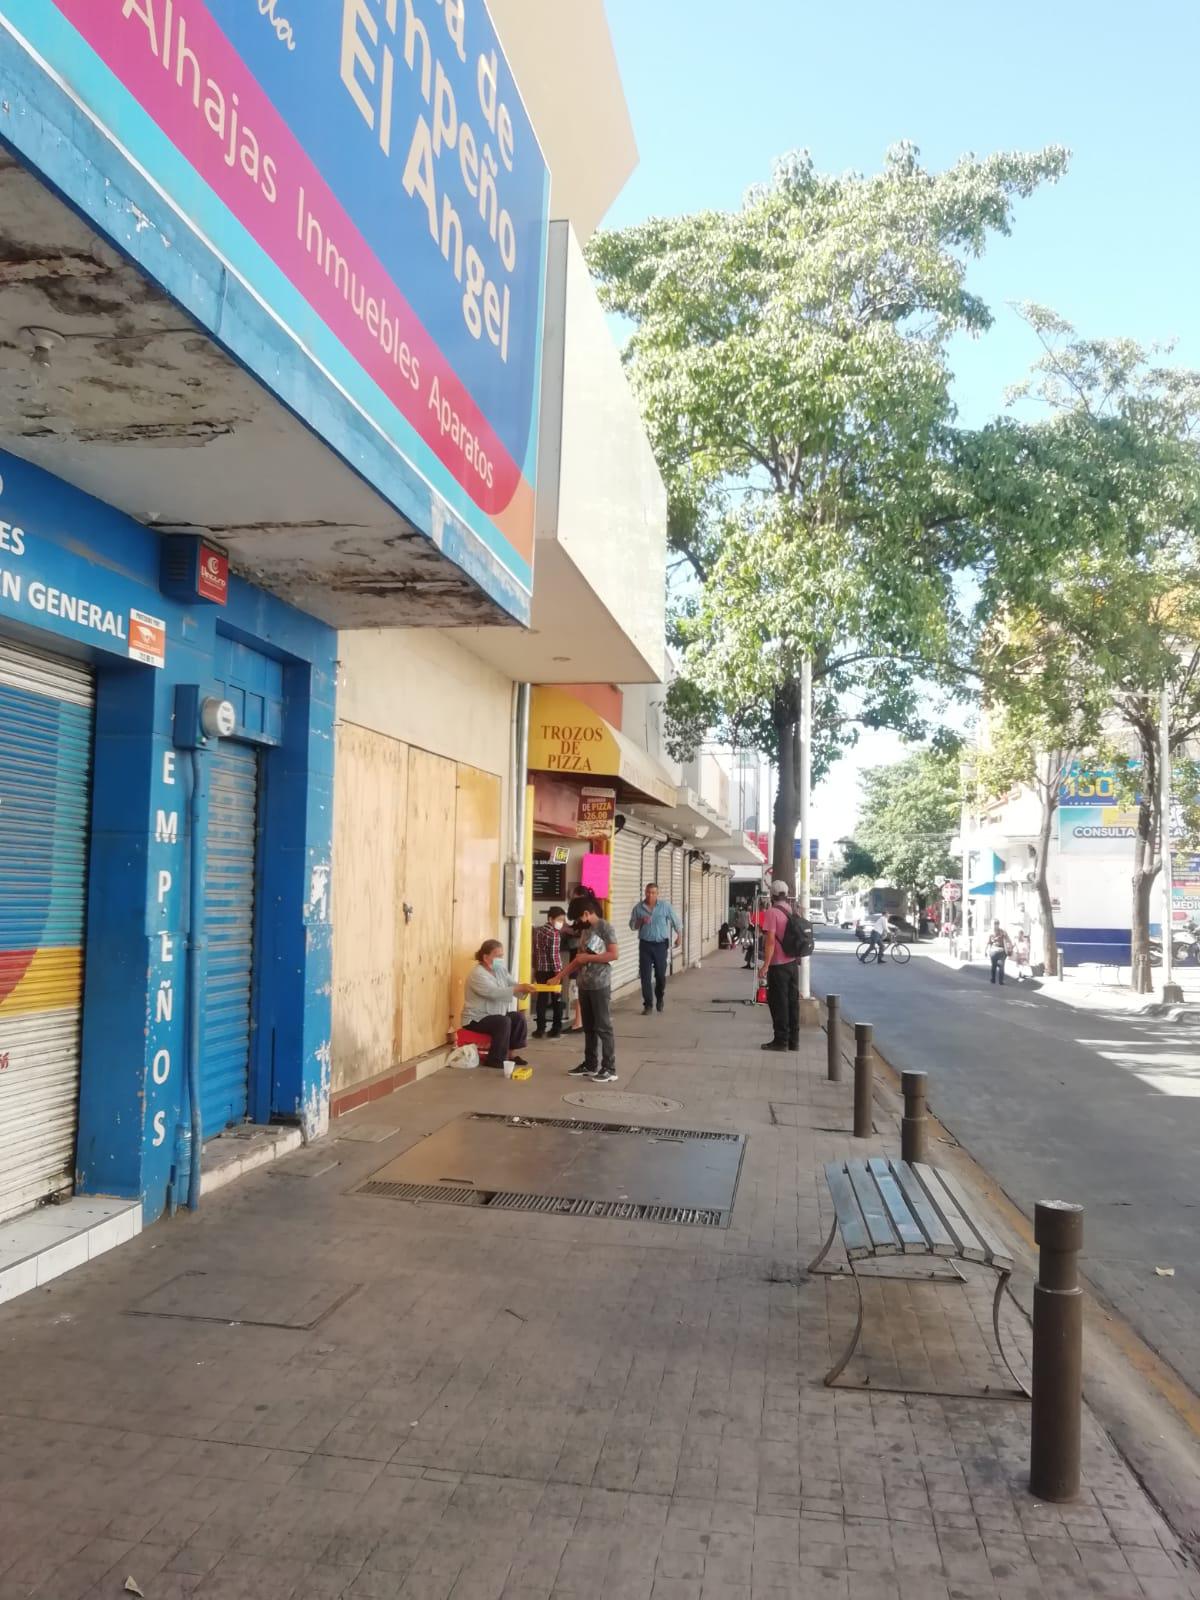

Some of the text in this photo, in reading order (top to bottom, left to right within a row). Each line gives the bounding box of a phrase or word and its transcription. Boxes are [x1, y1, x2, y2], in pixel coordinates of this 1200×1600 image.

[376, 0, 517, 273] mpeño
[477, 48, 514, 173] de
[122, 0, 494, 490] Alhajas Inmuebles Aparatos
[402, 113, 512, 365] Angel
[0, 568, 127, 640] N GENERAL
[541, 725, 604, 741] TROZOS
[548, 754, 592, 772] PIZZA
[560, 740, 581, 755] DE
[591, 802, 612, 811] PIZZA
[1073, 826, 1136, 838] CONSULTA
[151, 751, 178, 1147] EMPEÑOS
